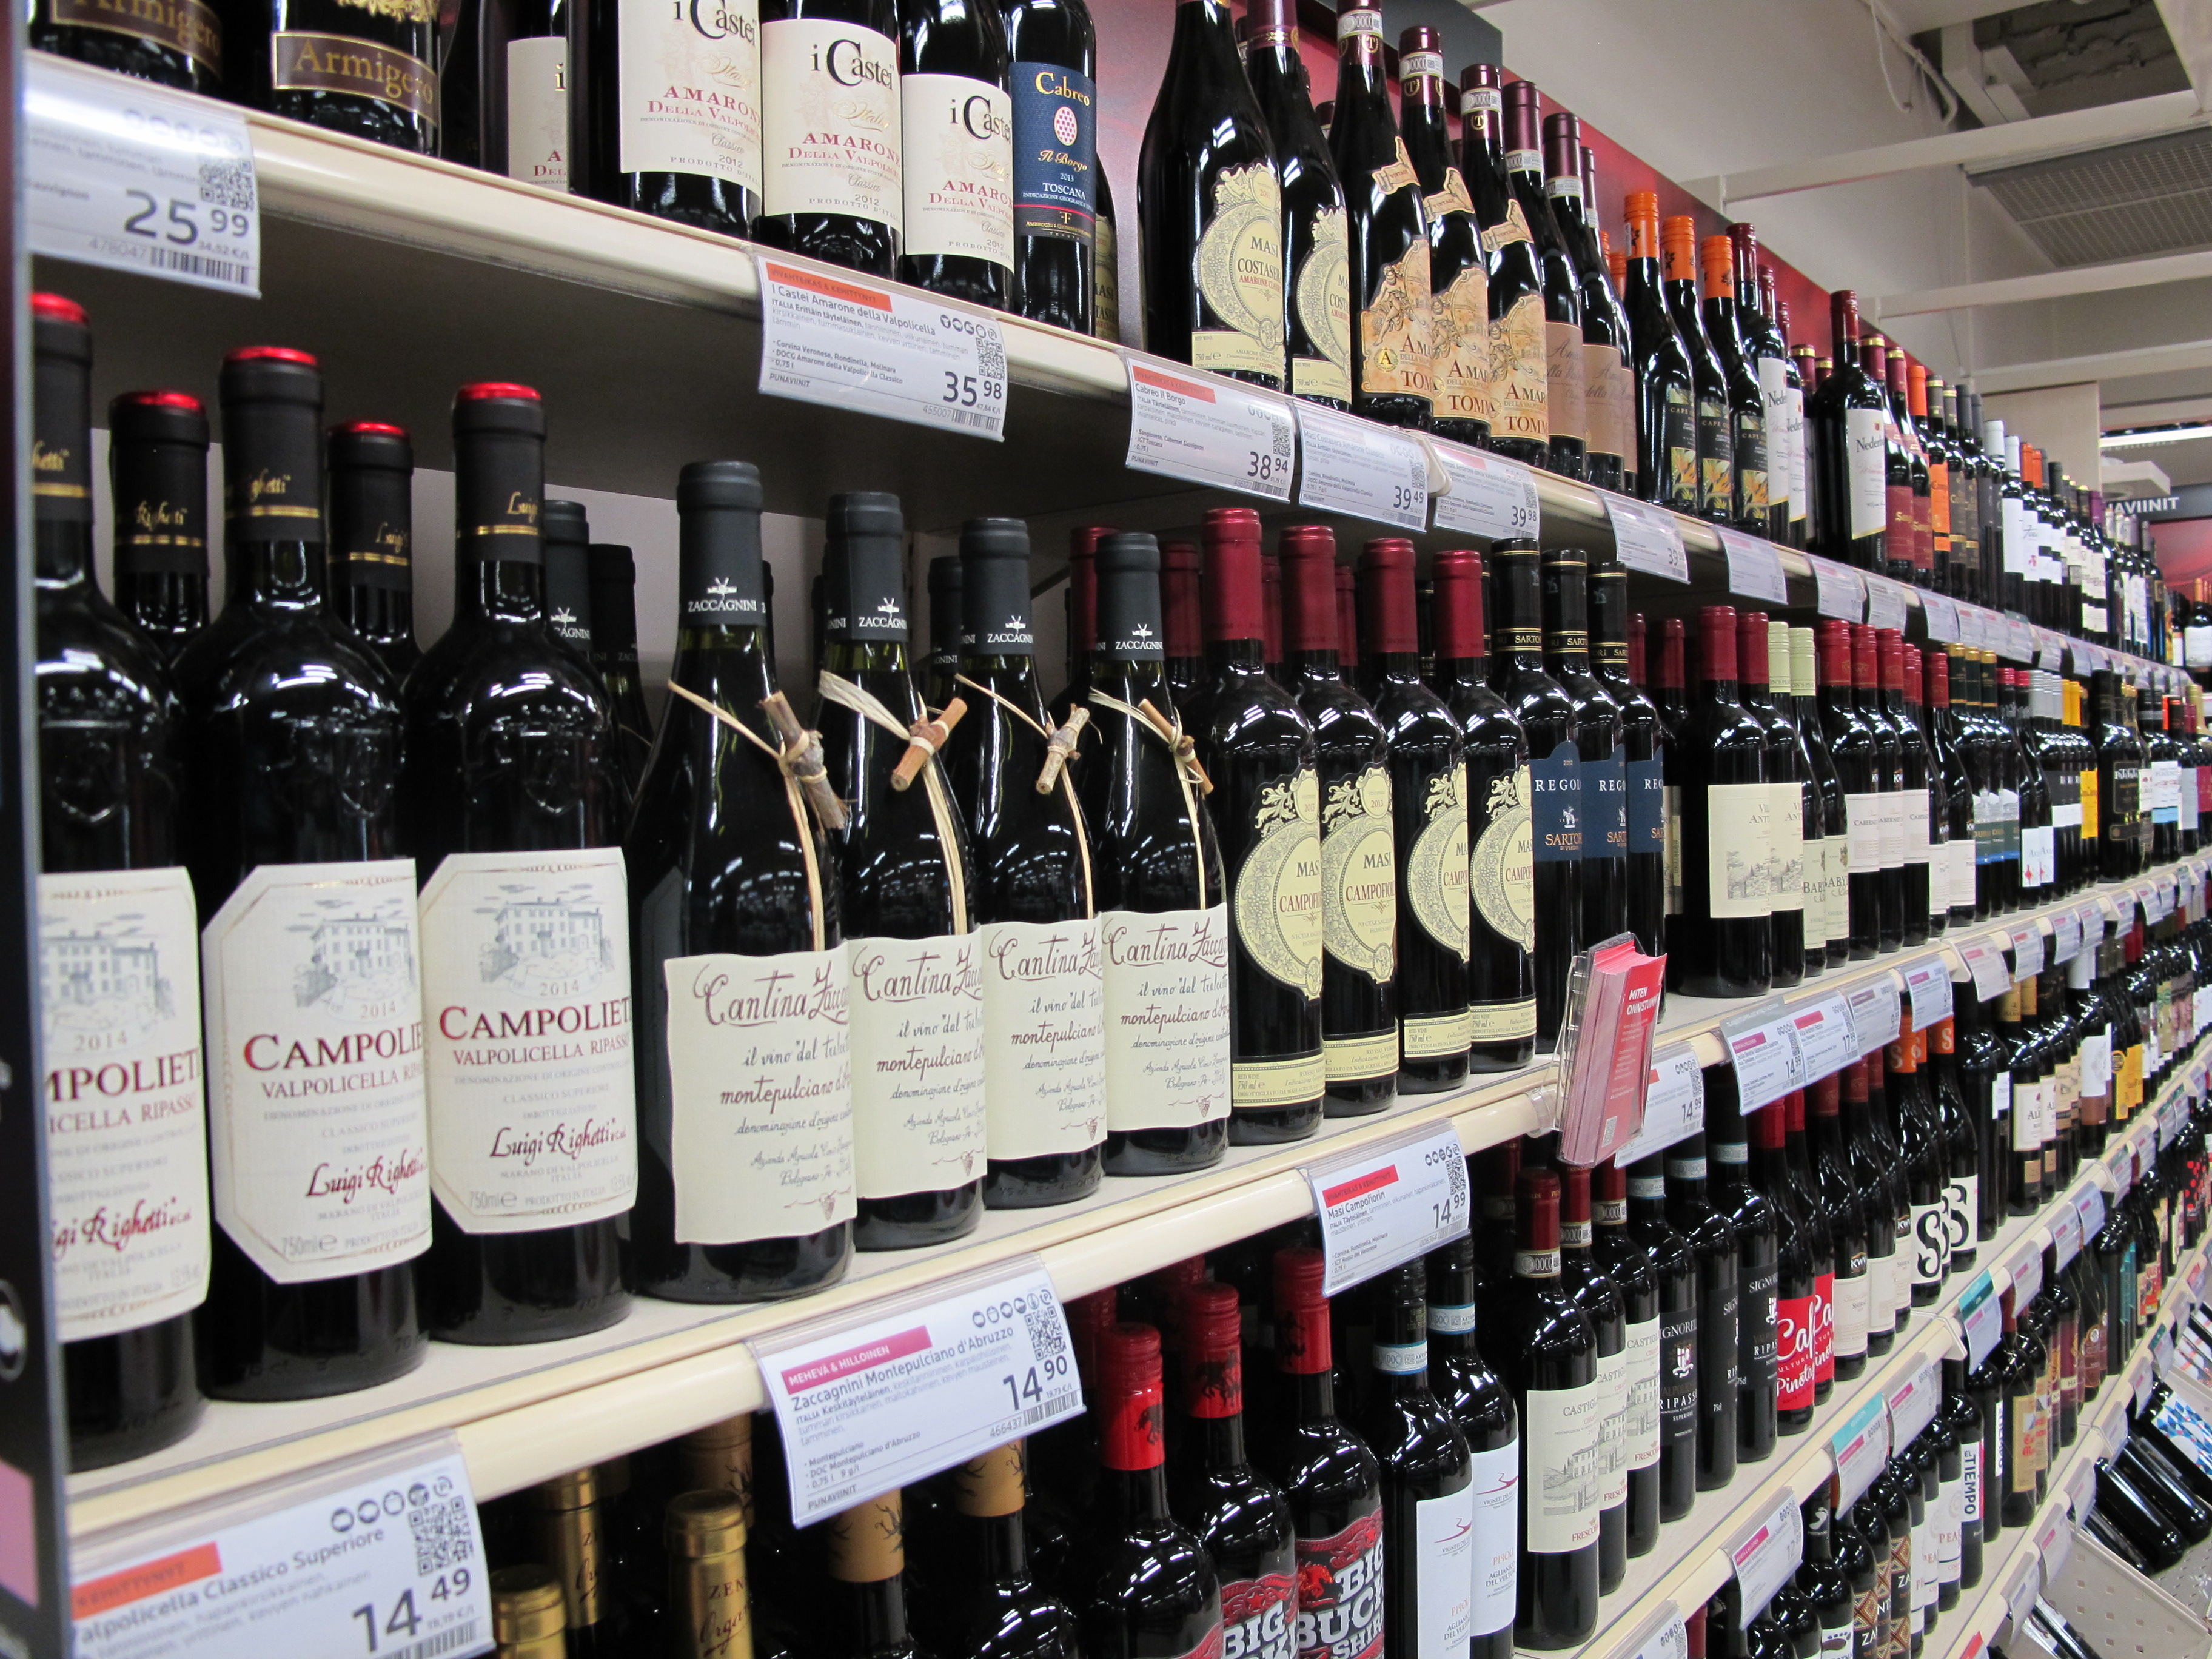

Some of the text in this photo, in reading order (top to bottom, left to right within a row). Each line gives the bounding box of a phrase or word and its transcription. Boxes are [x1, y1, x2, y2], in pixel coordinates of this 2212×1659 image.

[293, 39, 433, 104] Armigero
[1035, 71, 1090, 107] Cabreo
[669, 156, 732, 172] PRODOTTO
[719, 154, 743, 169] 2012
[1055, 152, 1088, 172] Borgo
[1060, 172, 1074, 183] 2013
[854, 193, 880, 206] 2012
[1042, 182, 1086, 201] TOSCANA
[808, 198, 870, 210] PRODOTTO
[124, 190, 249, 245] 25 99
[948, 241, 998, 255] PRODOTTO
[986, 238, 1005, 250] 2012
[772, 298, 794, 310] ITALIA
[778, 286, 809, 303] Castei
[812, 295, 856, 315] Amarone
[857, 307, 881, 321] della
[882, 313, 936, 335] Valpolicella
[776, 340, 801, 352] Corvina
[871, 360, 896, 373] Molinara
[776, 349, 903, 384] DOCG Amarone della Classico
[769, 373, 810, 387] PUNAVIINIT
[943, 371, 1002, 407] 35 98
[1136, 383, 1186, 406] Cabreo Borgo
[1247, 451, 1272, 480] 38
[1275, 458, 1289, 474] 94
[1393, 486, 1424, 511] 39 49
[1511, 506, 1527, 528] 39
[1528, 509, 1537, 522] 98
[1669, 548, 1678, 566] 39
[688, 600, 757, 614] ZACCAGNINI
[1371, 799, 1384, 809] 2013
[1363, 853, 1392, 870] MASI
[1102, 918, 1188, 967] Cantina
[989, 929, 1078, 981] Cantina
[853, 946, 951, 1002] Cantina
[540, 979, 580, 997] 2014
[694, 964, 808, 1026] Cantina
[1137, 980, 1176, 997] il vino
[1629, 986, 1649, 1000] MITEN
[360, 1004, 397, 1021] 2014
[1029, 996, 1067, 1014] il vino
[897, 1020, 939, 1038] il vino
[1121, 1004, 1210, 1033] montepulciano
[75, 1033, 127, 1053] 2014
[1011, 1020, 1096, 1053] montepulciano
[1131, 1034, 1187, 1050] denominazione
[1843, 1034, 1851, 1053] 17
[1942, 1027, 1953, 1051] S
[454, 1042, 584, 1065] VALPOLICELLA
[743, 1046, 791, 1066] il vino
[877, 1048, 972, 1081] montepulciano
[1022, 1055, 1078, 1070] denominazione
[1890, 1044, 1902, 1068] S
[1786, 1058, 1795, 1078] 14
[1795, 1056, 1801, 1067] 99
[261, 1070, 399, 1099] VALPOLICELLA
[720, 1074, 833, 1114] montepulciano
[890, 1083, 952, 1099] denominazione
[1681, 1097, 1702, 1124] 14 99
[734, 1116, 807, 1136] denominazione
[489, 1116, 610, 1167] Luigi Righetti
[306, 1162, 364, 1204] Luigi
[1328, 1190, 1386, 1220] Masi Campofiorin
[1432, 1191, 1466, 1230] 14 99
[82, 1197, 177, 1252] Righetti
[1917, 1210, 1941, 1278] S
[788, 1345, 890, 1386] MEHEVÄ & HILLOINEN
[792, 1326, 1014, 1412] Zaccagnini Montepulciano d'Abruzzo
[1003, 1355, 1068, 1412] 14 90
[797, 1412, 820, 1424] ITALIA
[989, 1416, 1023, 1439] 466437
[808, 1441, 864, 1467] Montepulciano
[810, 1430, 920, 1478] DOC Montepulciano d'Abruzzo
[848, 1465, 860, 1476] g/l
[1964, 1454, 1976, 1515] TIEMPO
[808, 1484, 857, 1510] PUNAVIINIT
[204, 1526, 384, 1600] Classico Superiore
[1486, 1577, 1498, 1587] DEL
[352, 1568, 471, 1652] 14 49
[1222, 1606, 1287, 1658] BIG
